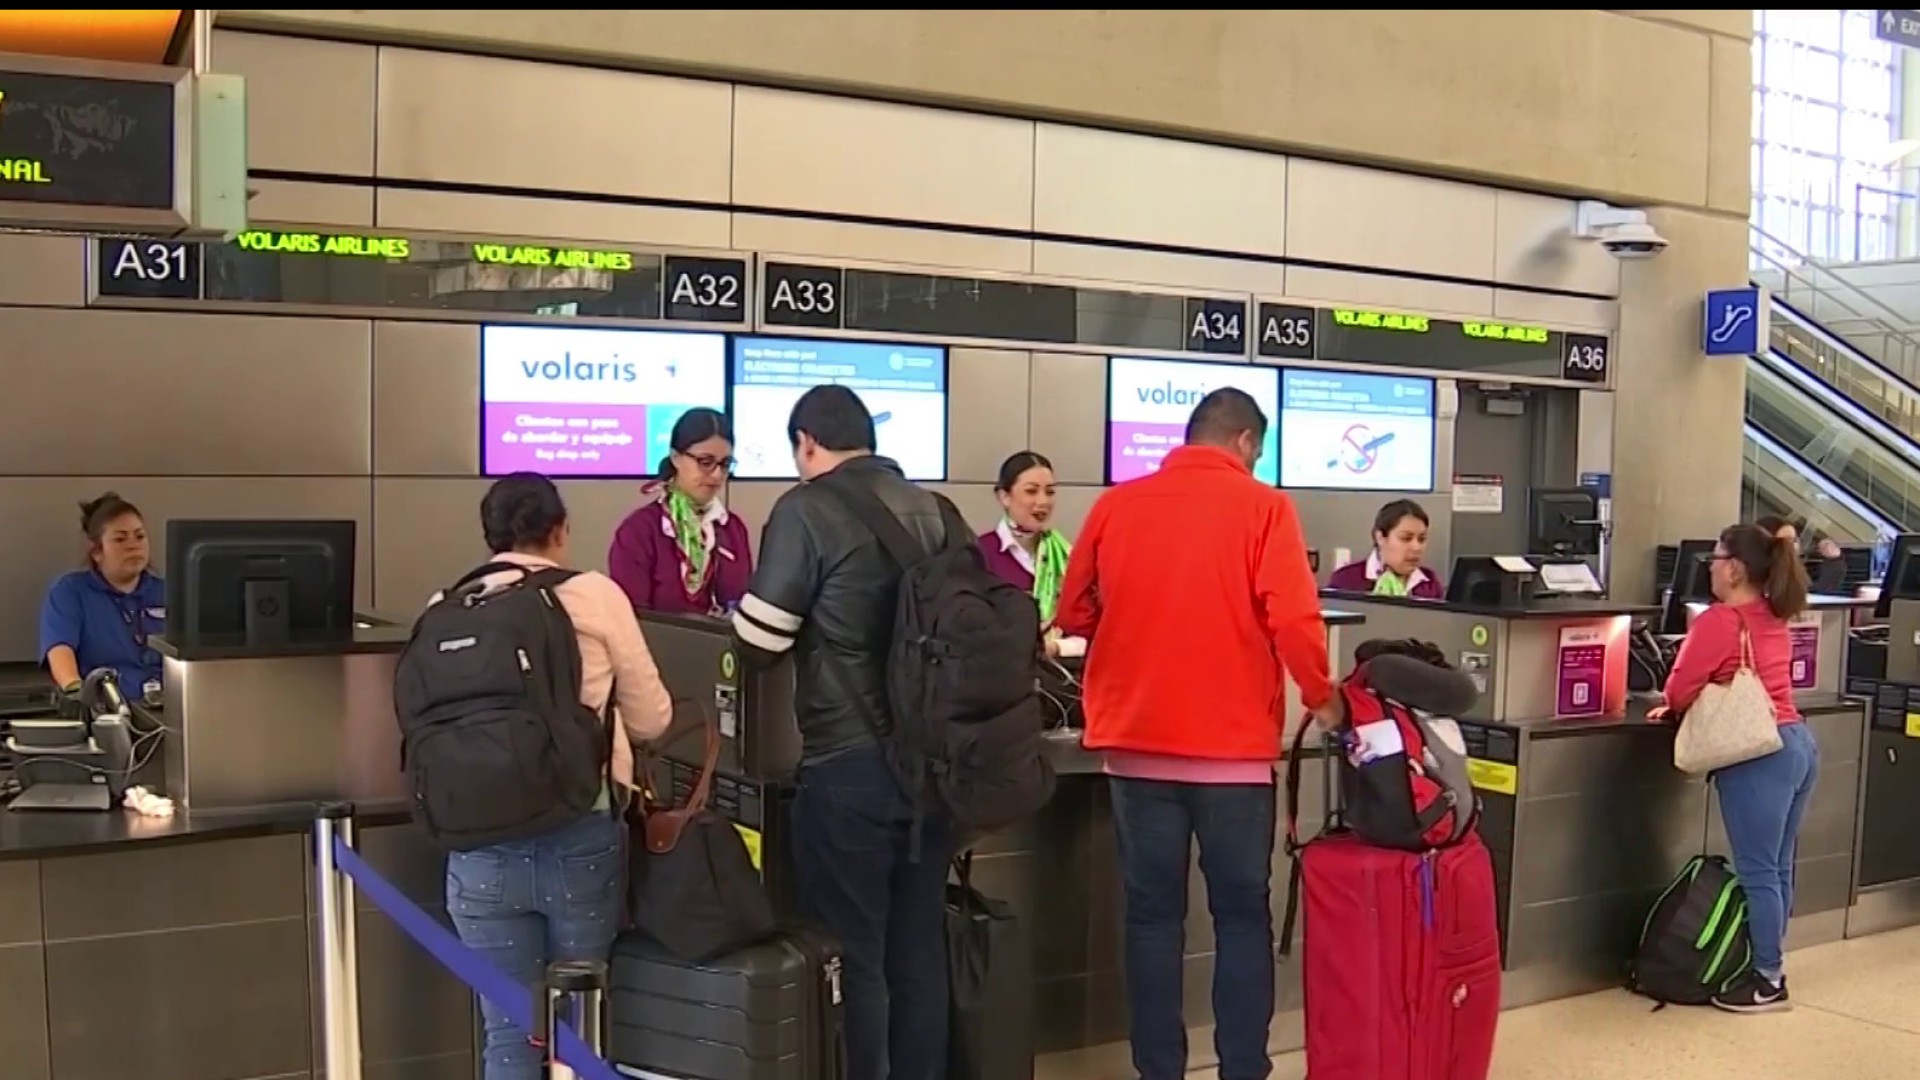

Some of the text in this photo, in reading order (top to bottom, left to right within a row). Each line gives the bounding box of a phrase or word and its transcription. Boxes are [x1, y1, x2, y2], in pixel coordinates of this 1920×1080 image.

[237, 230, 410, 258] VOLARIS AIRLINES
[473, 243, 633, 271] VOLARIS AIRLINES
[113, 242, 187, 281] A31
[671, 272, 739, 308] A32
[770, 280, 836, 313] A33
[1191, 311, 1241, 341] A34
[1262, 317, 1310, 347] A35
[1333, 308, 1430, 333] VOLARIS AIRLINES
[1462, 320, 1548, 343] VOLARIS AIRLINES
[520, 351, 638, 382] volaris
[1566, 344, 1604, 371] A36
[1136, 380, 1209, 405] volari
